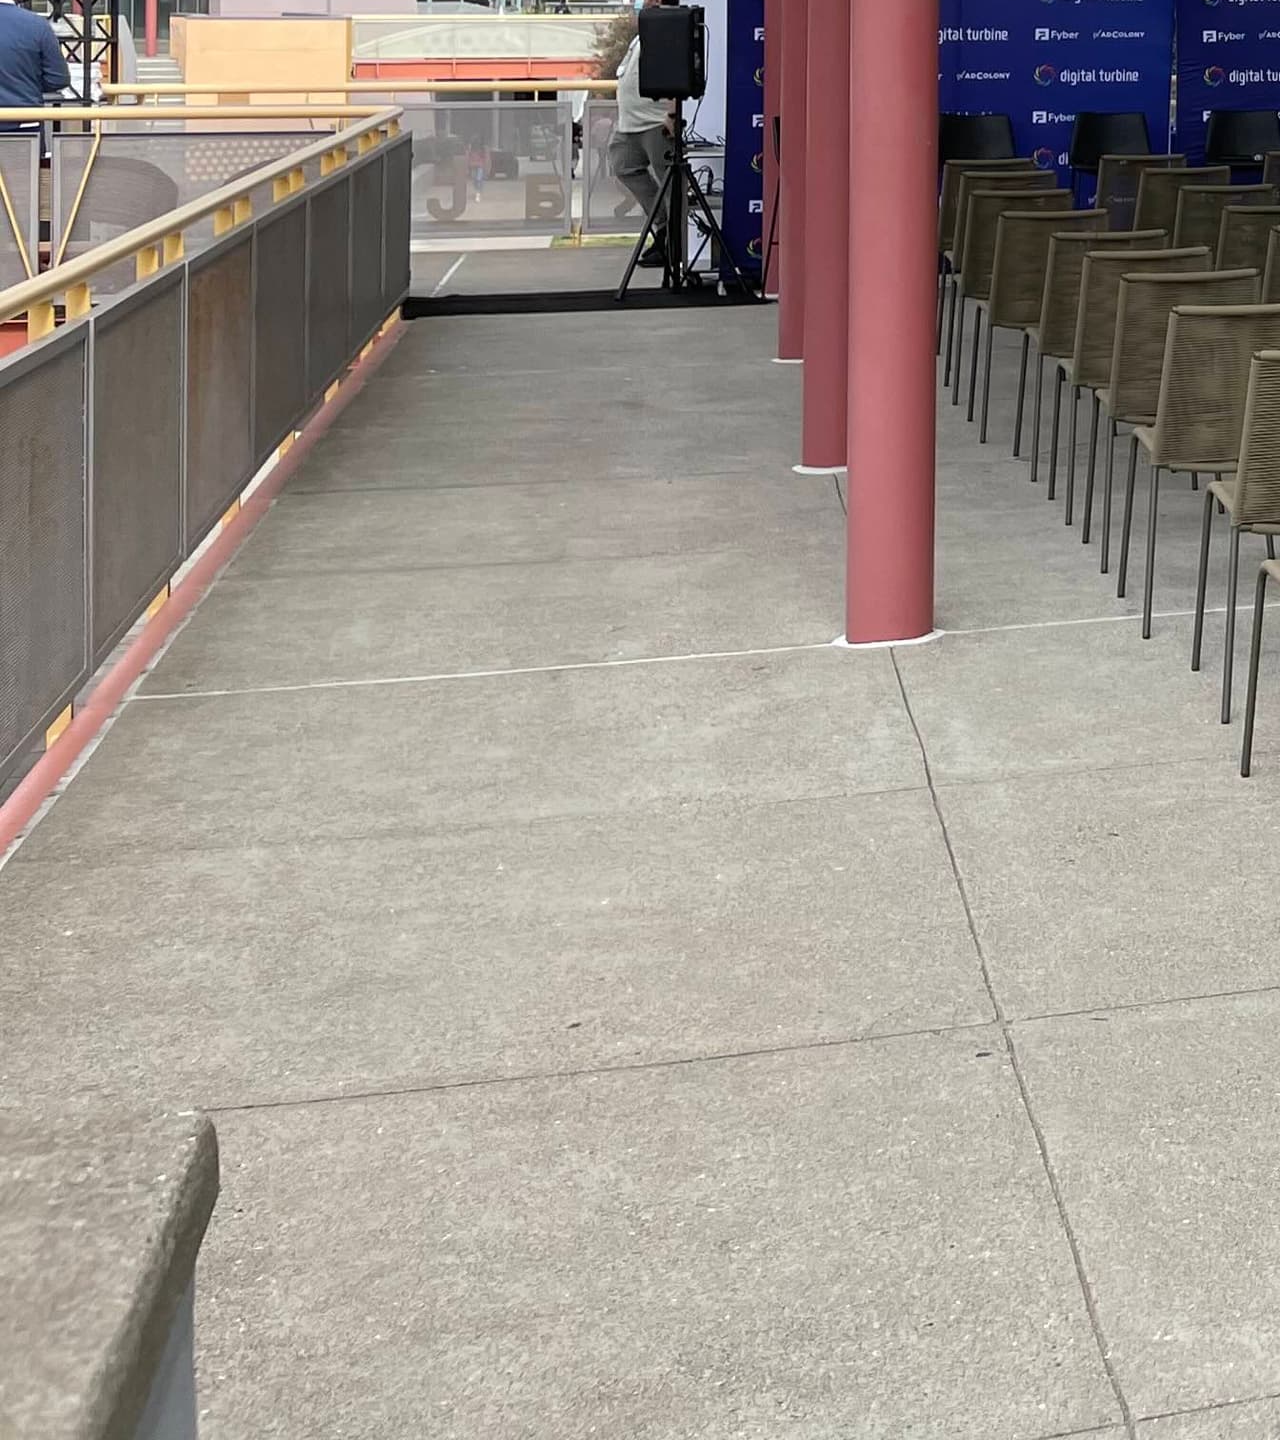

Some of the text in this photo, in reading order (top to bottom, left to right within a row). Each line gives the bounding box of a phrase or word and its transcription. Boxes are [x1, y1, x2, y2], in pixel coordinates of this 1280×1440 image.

[938, 27, 1008, 45] gital turbine
[1051, 29, 1079, 40] Fyber
[1218, 31, 1245, 42] Fyber
[1060, 68, 1139, 86] digital turbine
[1229, 68, 1264, 86] digital
[1048, 112, 1076, 124] Fyber
